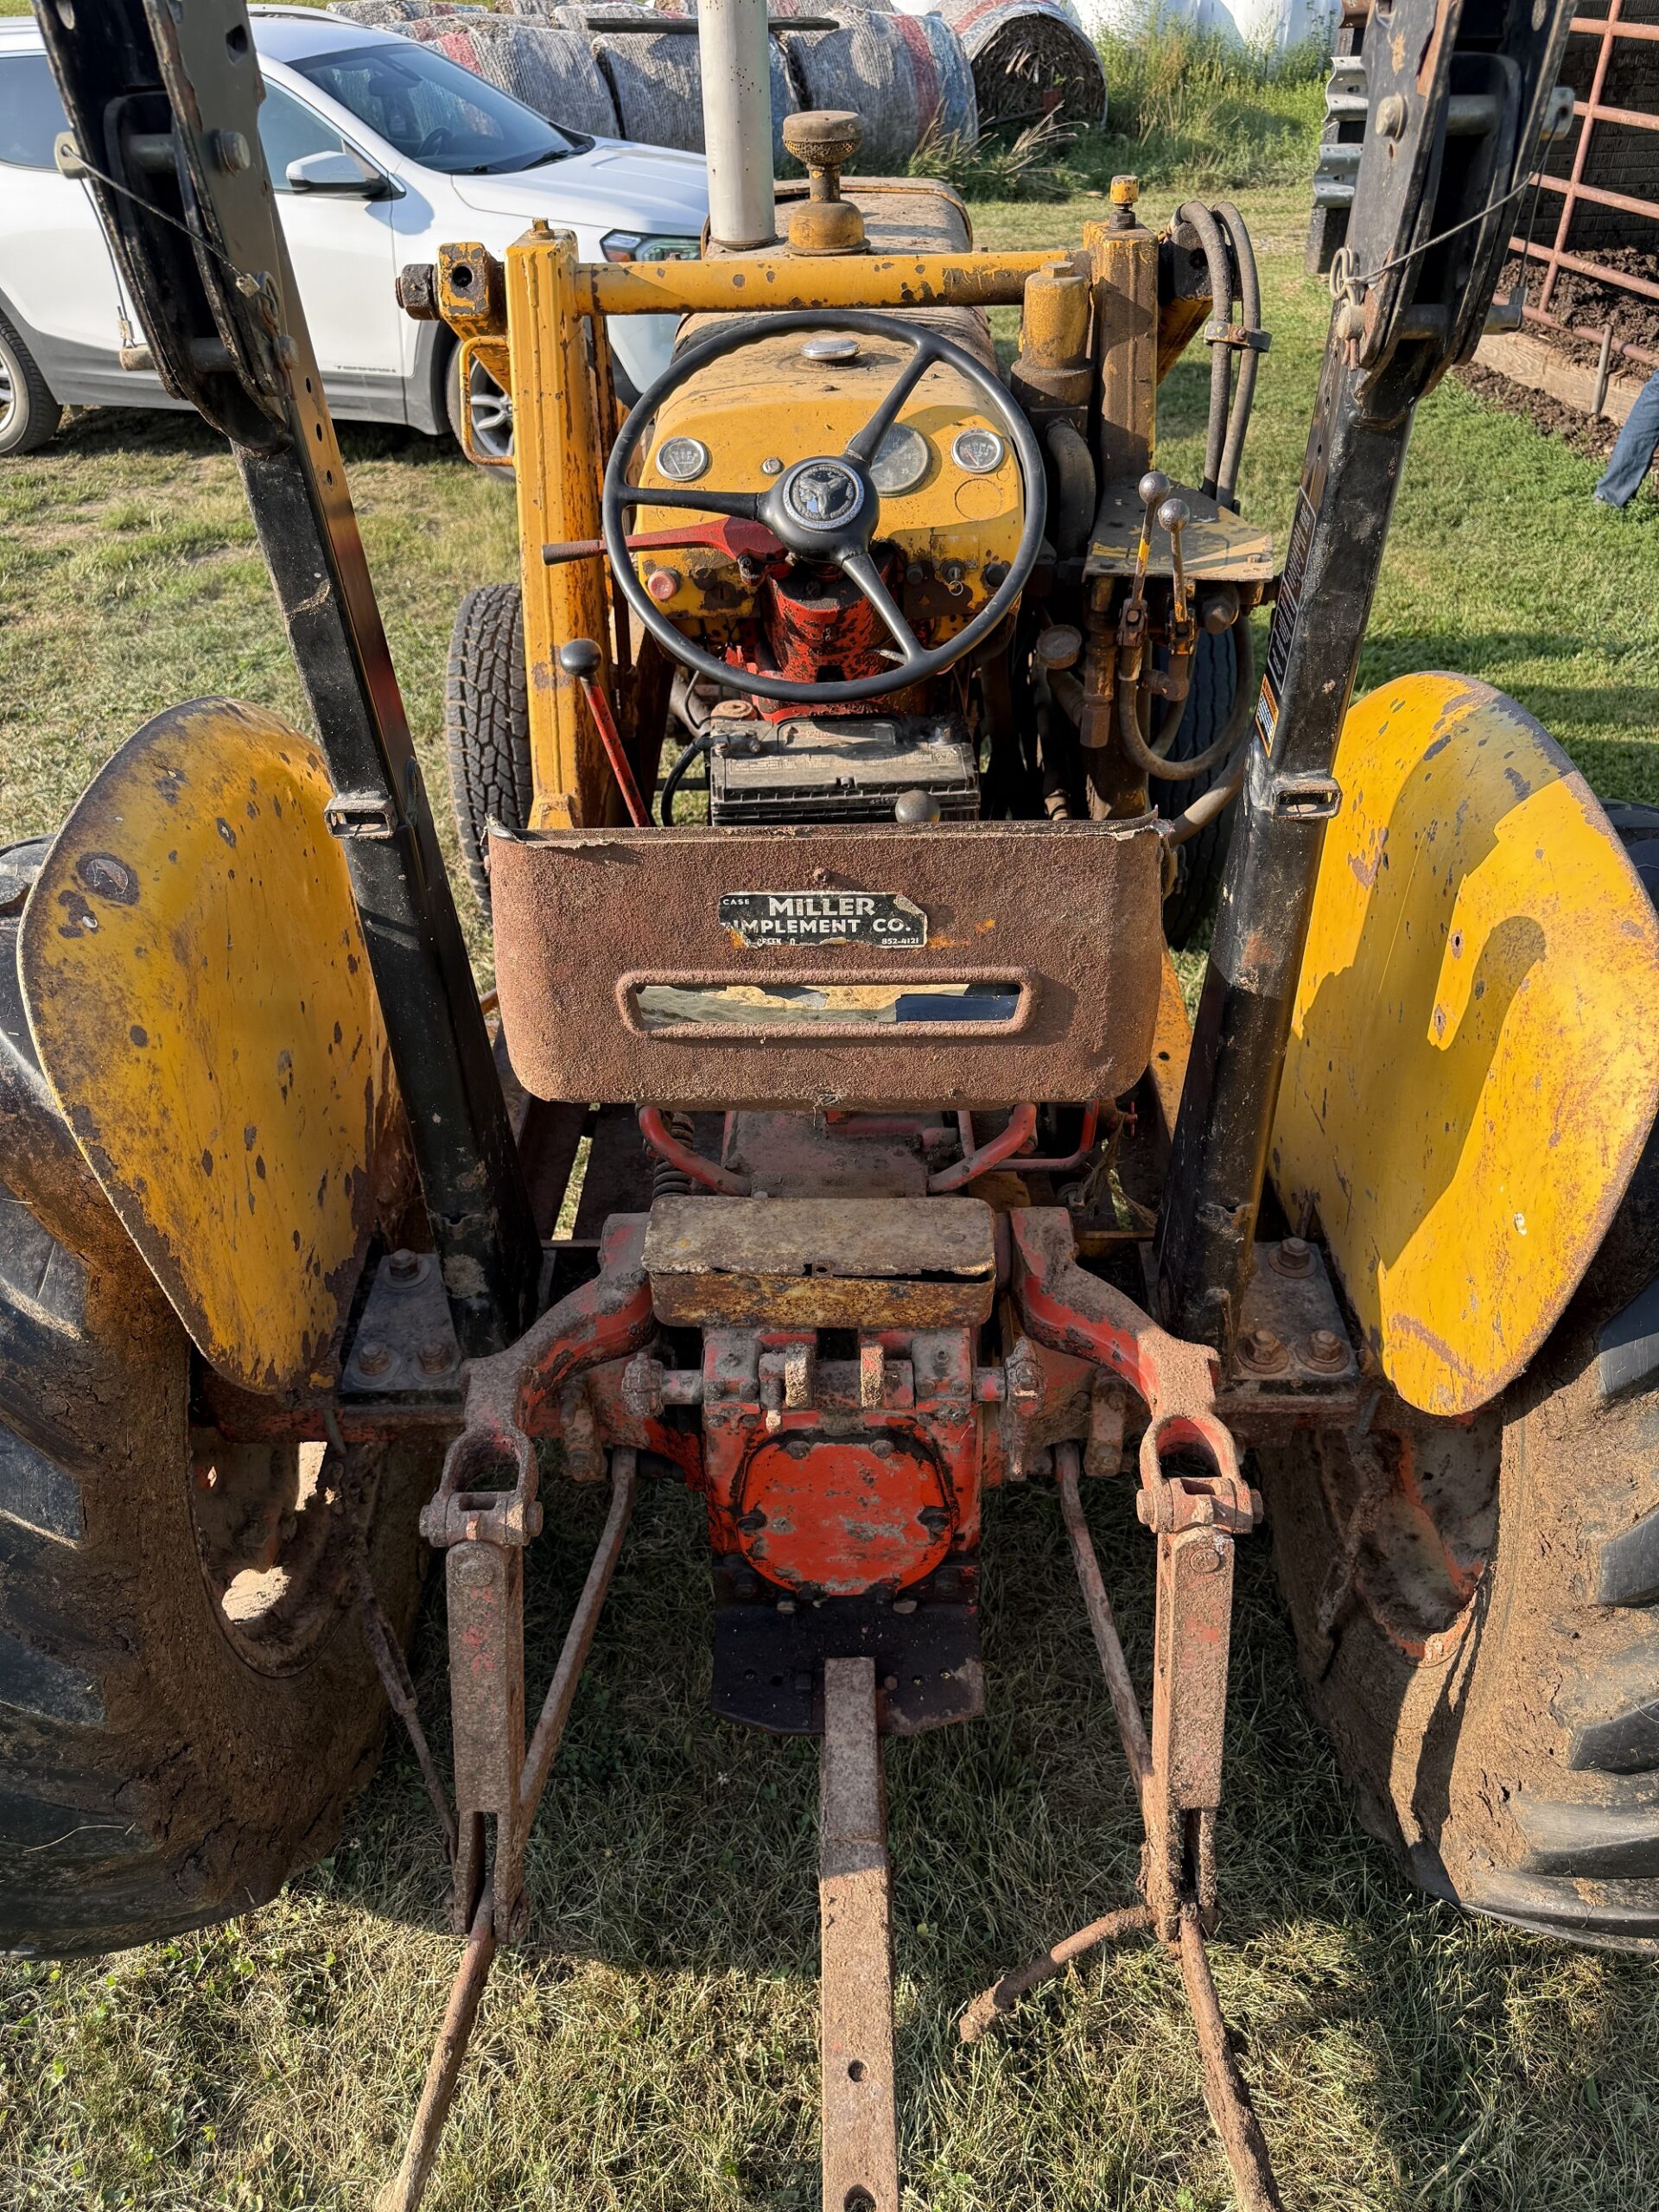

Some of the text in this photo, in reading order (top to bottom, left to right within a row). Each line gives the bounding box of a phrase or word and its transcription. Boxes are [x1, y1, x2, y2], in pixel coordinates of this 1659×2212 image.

[769, 897, 875, 917] MILLER
[733, 918, 911, 934] IMPLEMENT CO.
